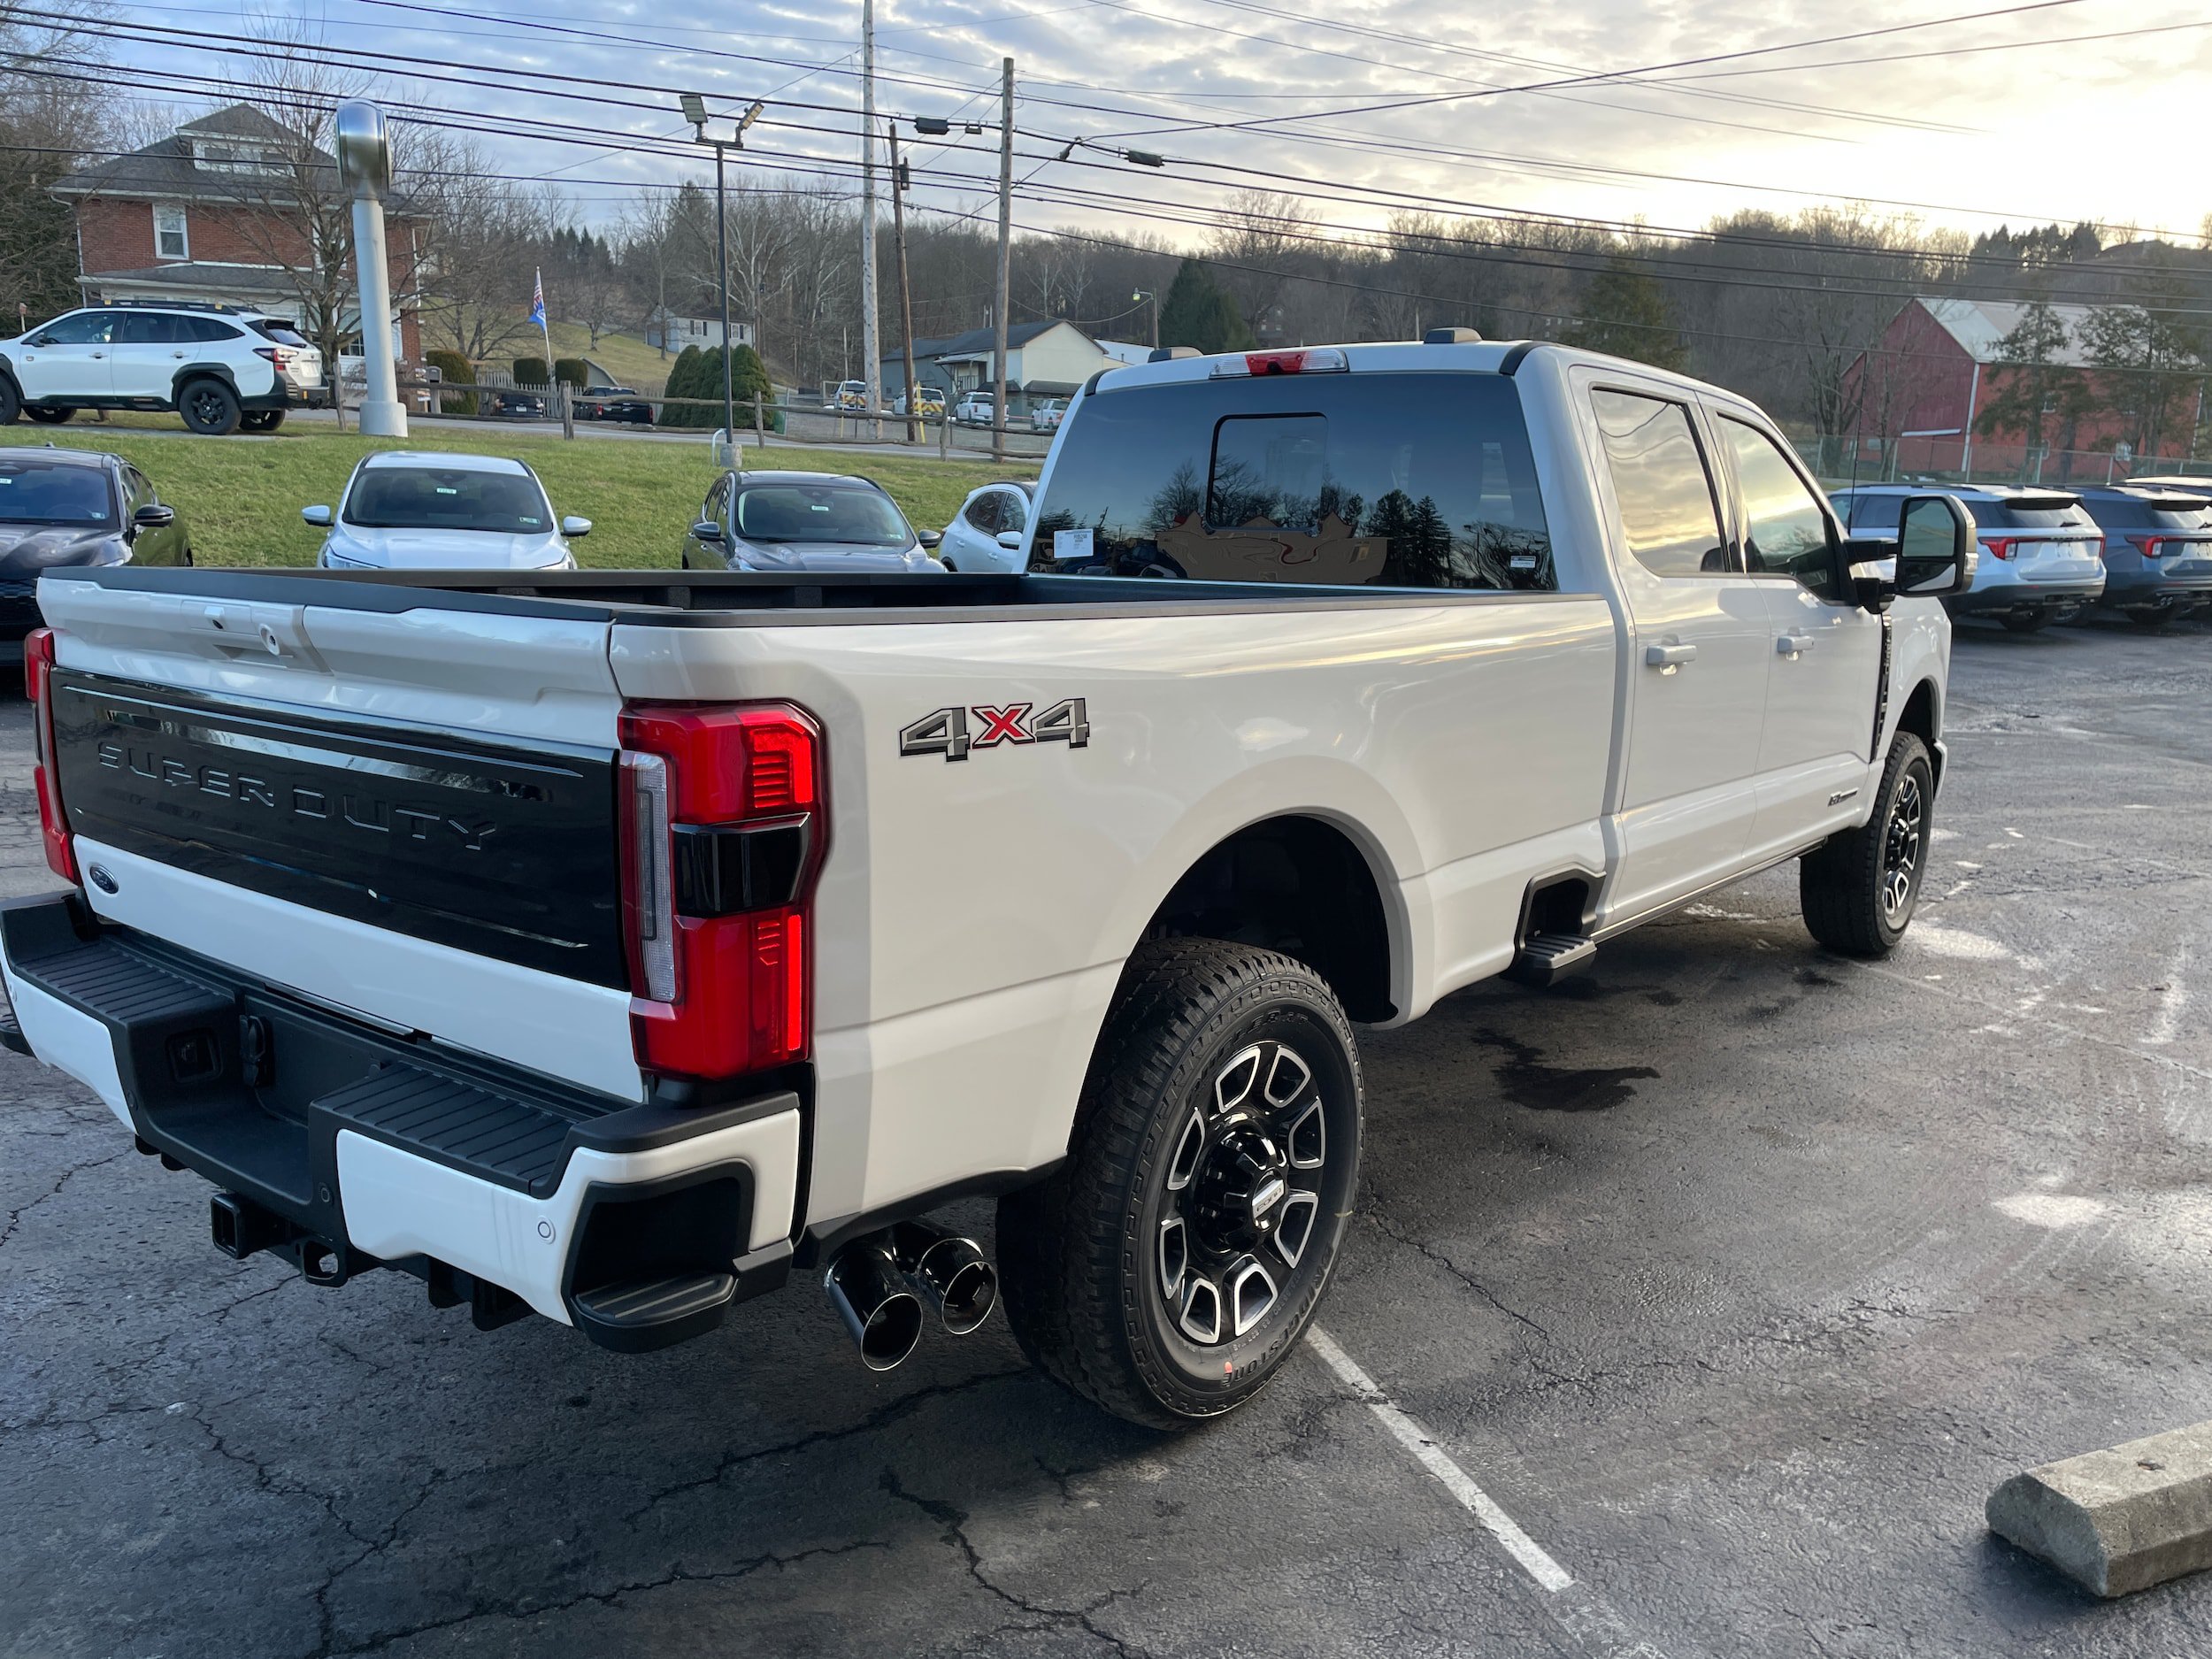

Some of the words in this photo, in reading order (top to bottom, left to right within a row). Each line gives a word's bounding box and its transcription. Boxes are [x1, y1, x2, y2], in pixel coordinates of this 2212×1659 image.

[97, 741, 275, 808] SUPER
[292, 787, 498, 852] DUTY
[1256, 1187, 1282, 1212] FORD
[1221, 1241, 1334, 1387] BRIDGESTONE
